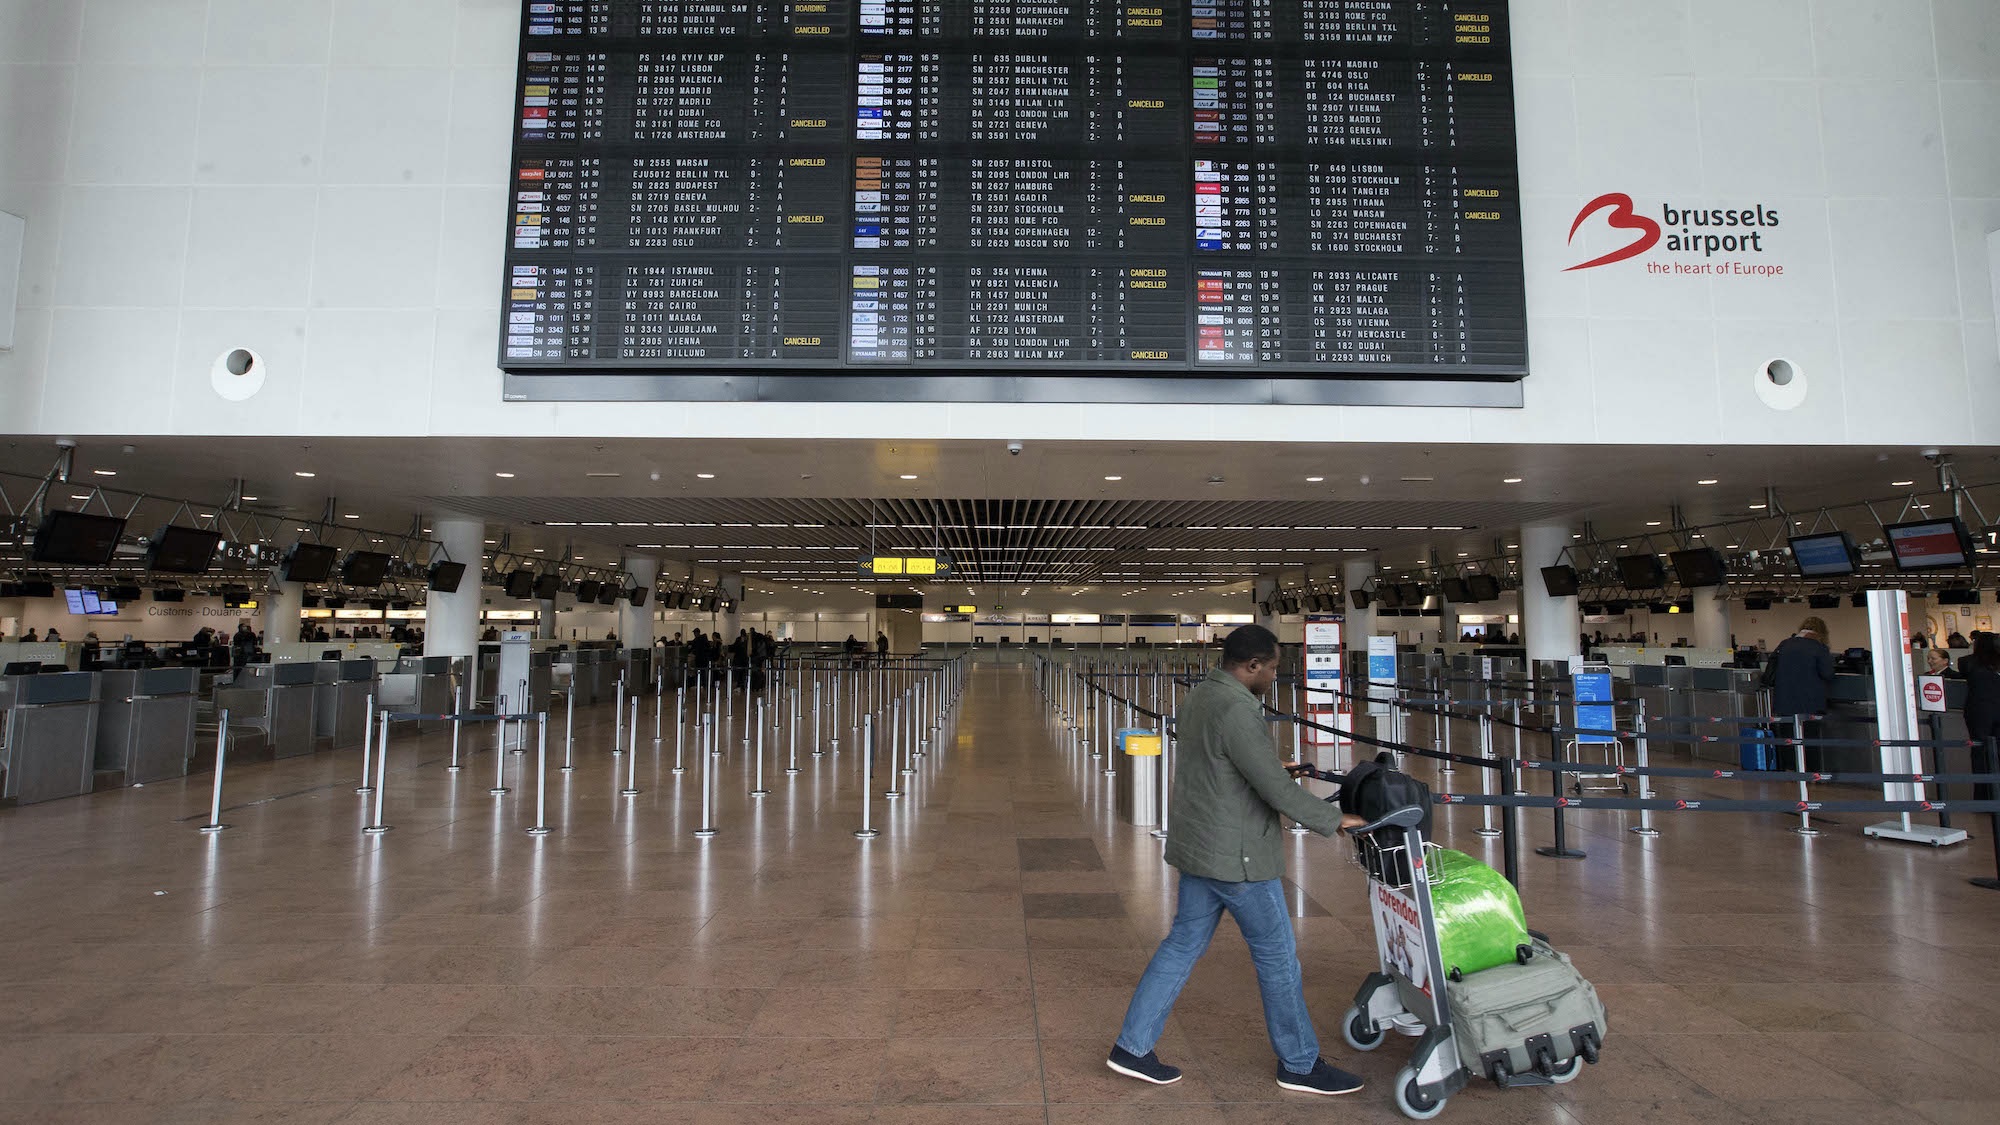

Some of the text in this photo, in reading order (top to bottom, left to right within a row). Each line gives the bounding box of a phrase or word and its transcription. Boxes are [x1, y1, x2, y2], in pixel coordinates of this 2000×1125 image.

[1664, 204, 1779, 227] brussels
[1666, 228, 1762, 257] airport
[1647, 262, 1784, 277] the heart of Europe
[228, 548, 243, 558] 6.2
[261, 551, 275, 560] 6.3
[1732, 558, 1747, 566] 7.3
[1763, 555, 1780, 565] 7.2
[149, 607, 194, 617] Customs
[202, 607, 241, 617] Douane
[1379, 886, 1420, 930] corendon
